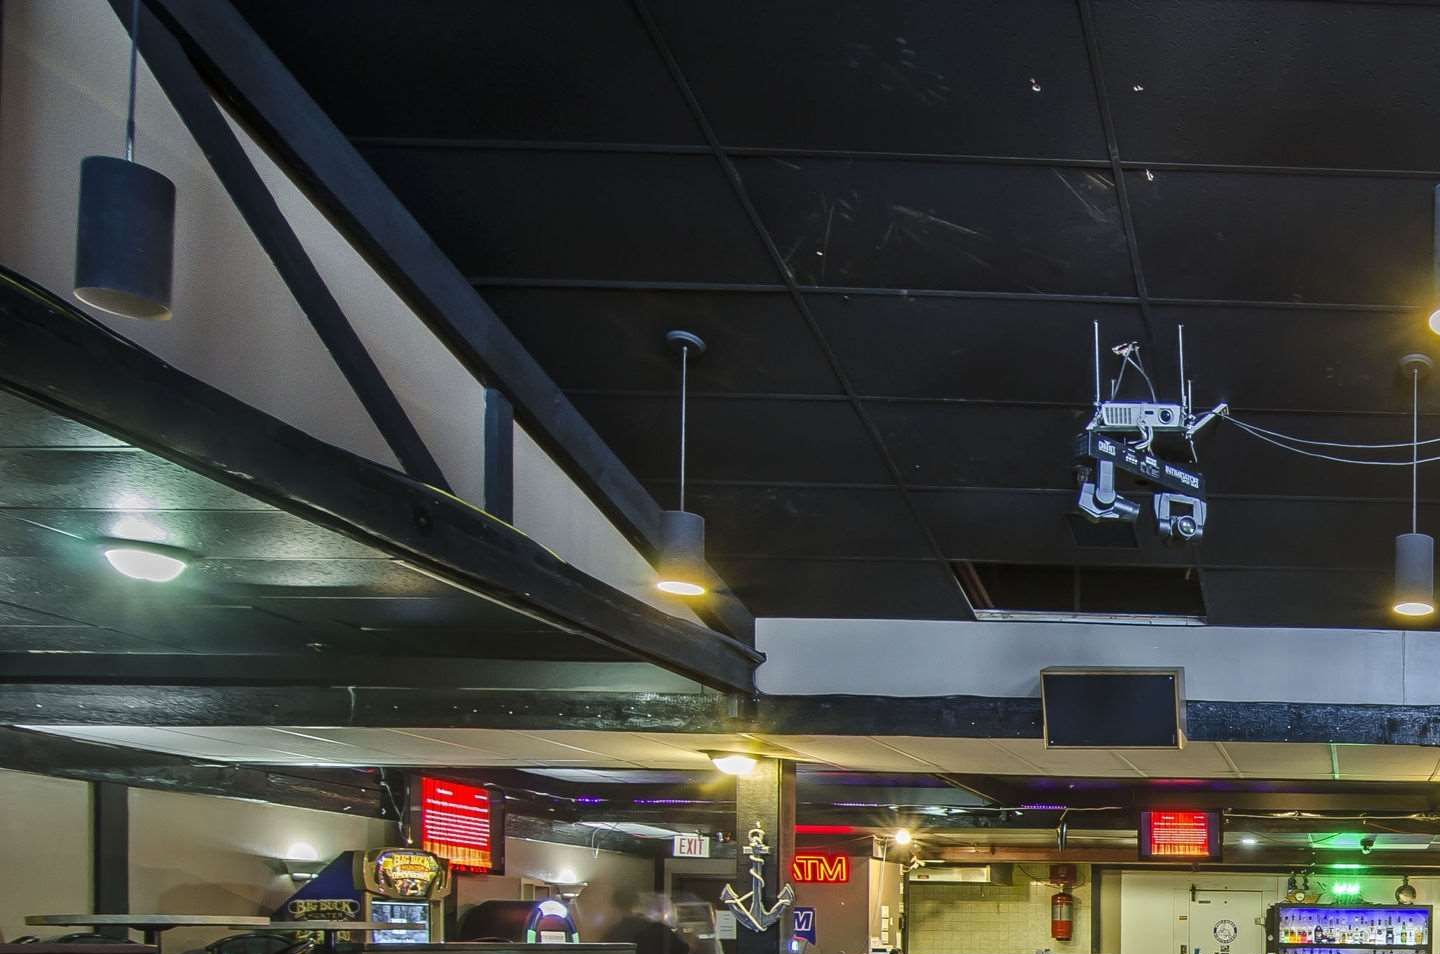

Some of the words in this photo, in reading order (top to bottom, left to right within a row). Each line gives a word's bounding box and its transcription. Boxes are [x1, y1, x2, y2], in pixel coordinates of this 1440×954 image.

[679, 838, 705, 855] EXIT
[296, 900, 318, 913] BIG
[320, 900, 353, 914] BUCK
